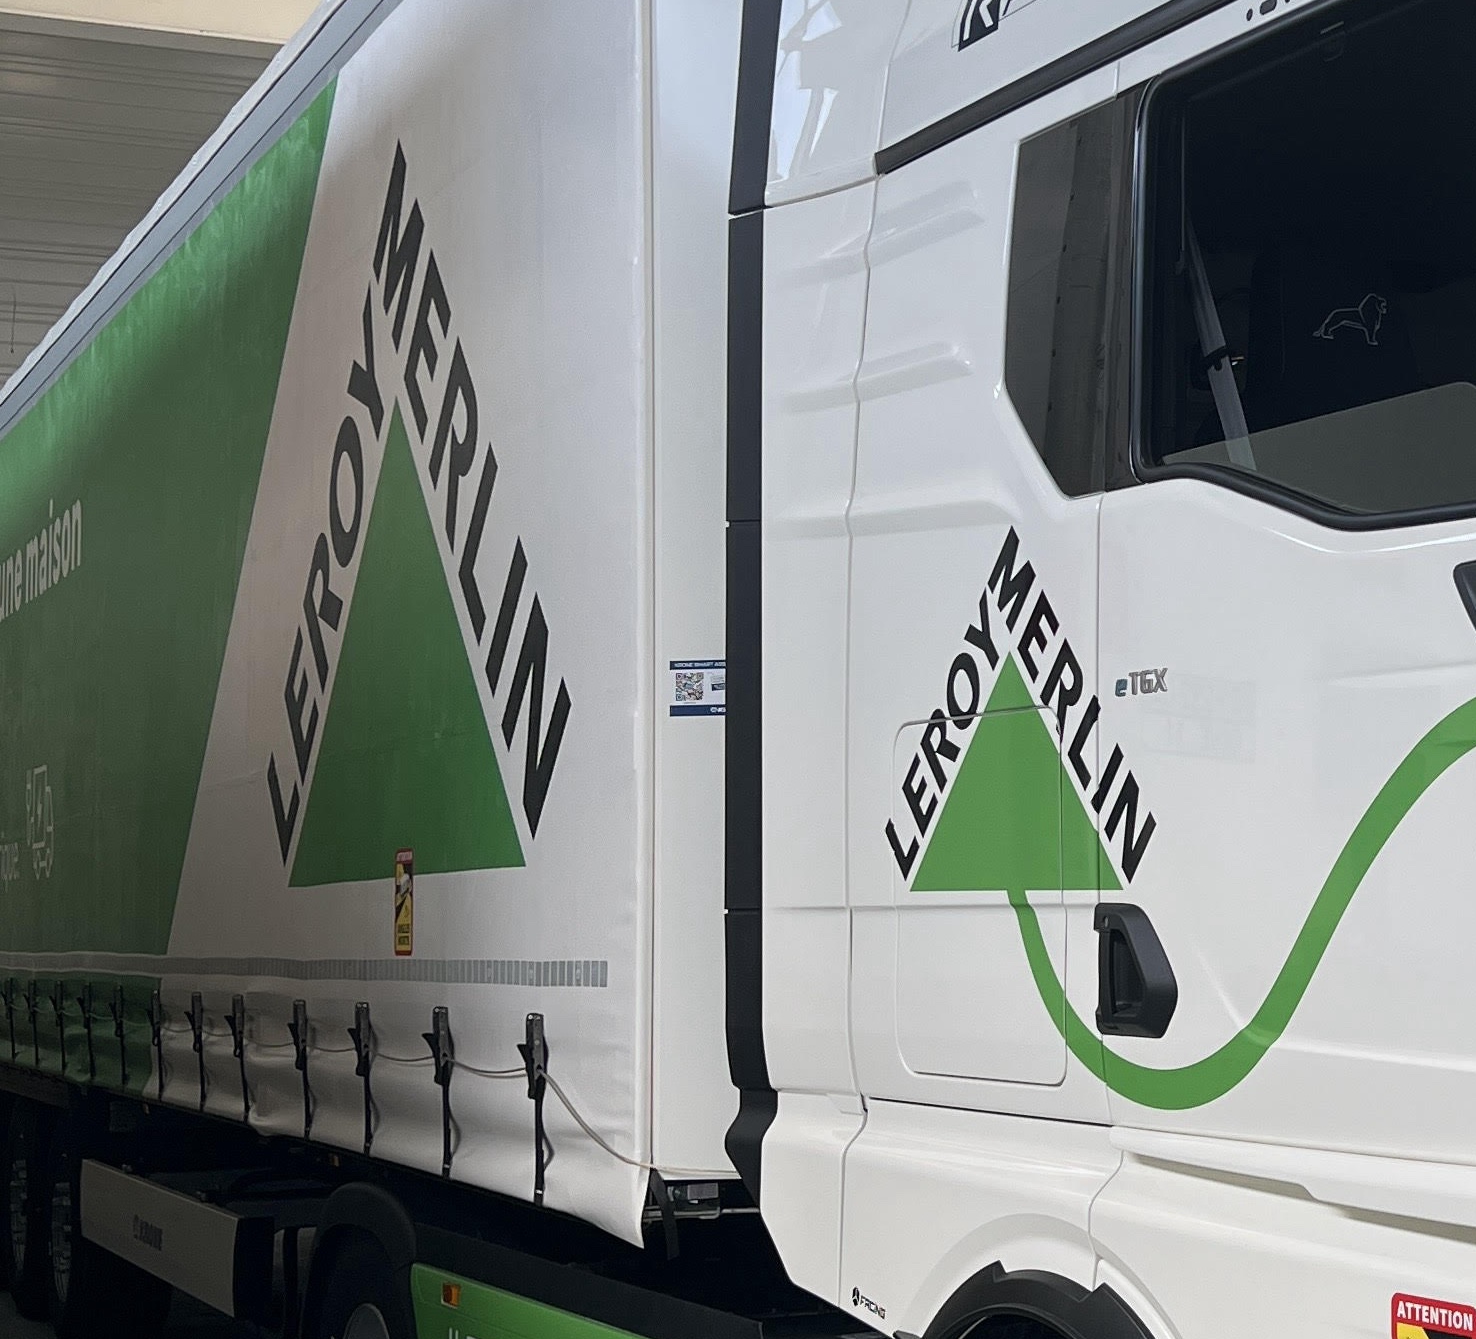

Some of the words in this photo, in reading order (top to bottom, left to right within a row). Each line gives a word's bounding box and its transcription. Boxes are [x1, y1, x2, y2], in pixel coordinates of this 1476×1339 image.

[25, 498, 82, 604] maison
[267, 281, 388, 866] LEROY
[373, 138, 572, 841] MERLIN
[885, 590, 999, 880] LEROY
[987, 525, 1157, 884] MERLIN
[1115, 667, 1168, 697] eTGX
[1396, 1300, 1474, 1331] ATTENTION
